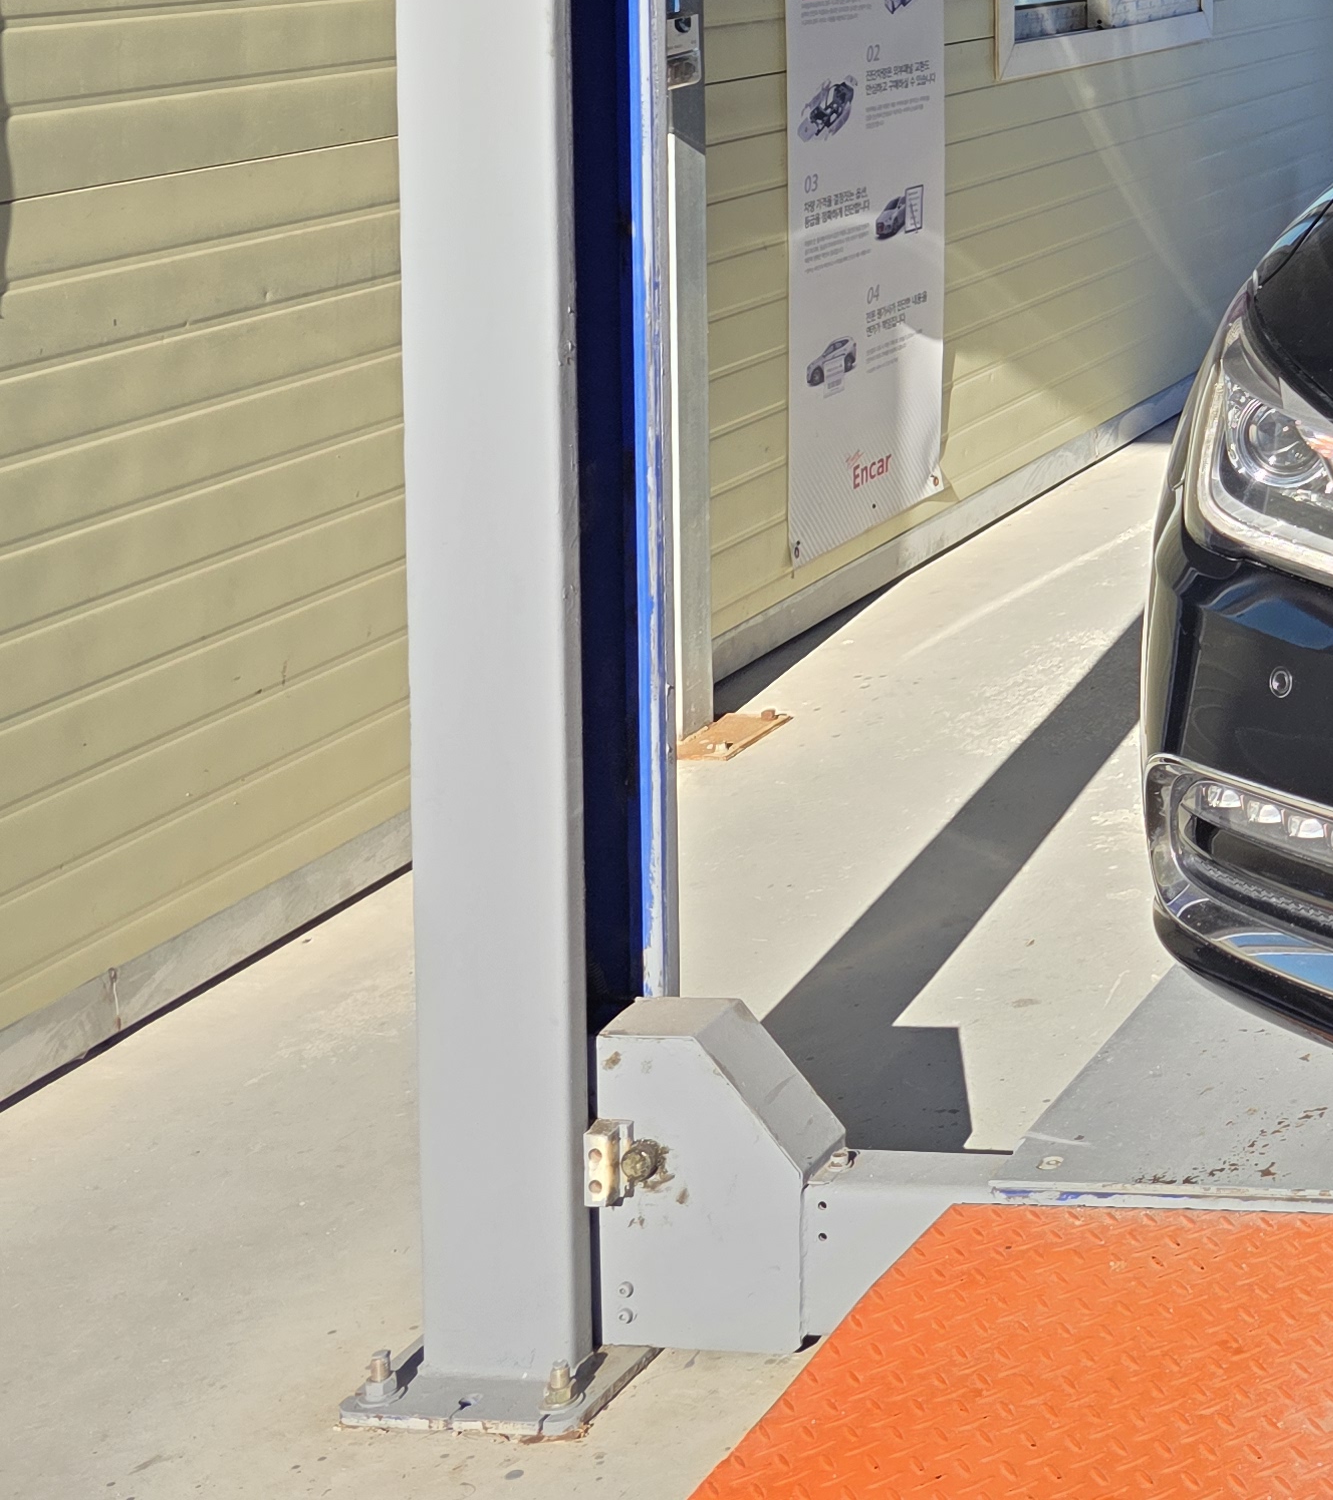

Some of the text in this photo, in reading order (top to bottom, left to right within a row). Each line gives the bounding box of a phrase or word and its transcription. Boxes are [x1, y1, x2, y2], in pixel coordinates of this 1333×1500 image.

[866, 44, 880, 62] 02
[804, 173, 819, 193] 03
[867, 284, 880, 304] 04
[852, 453, 892, 490] Encar
